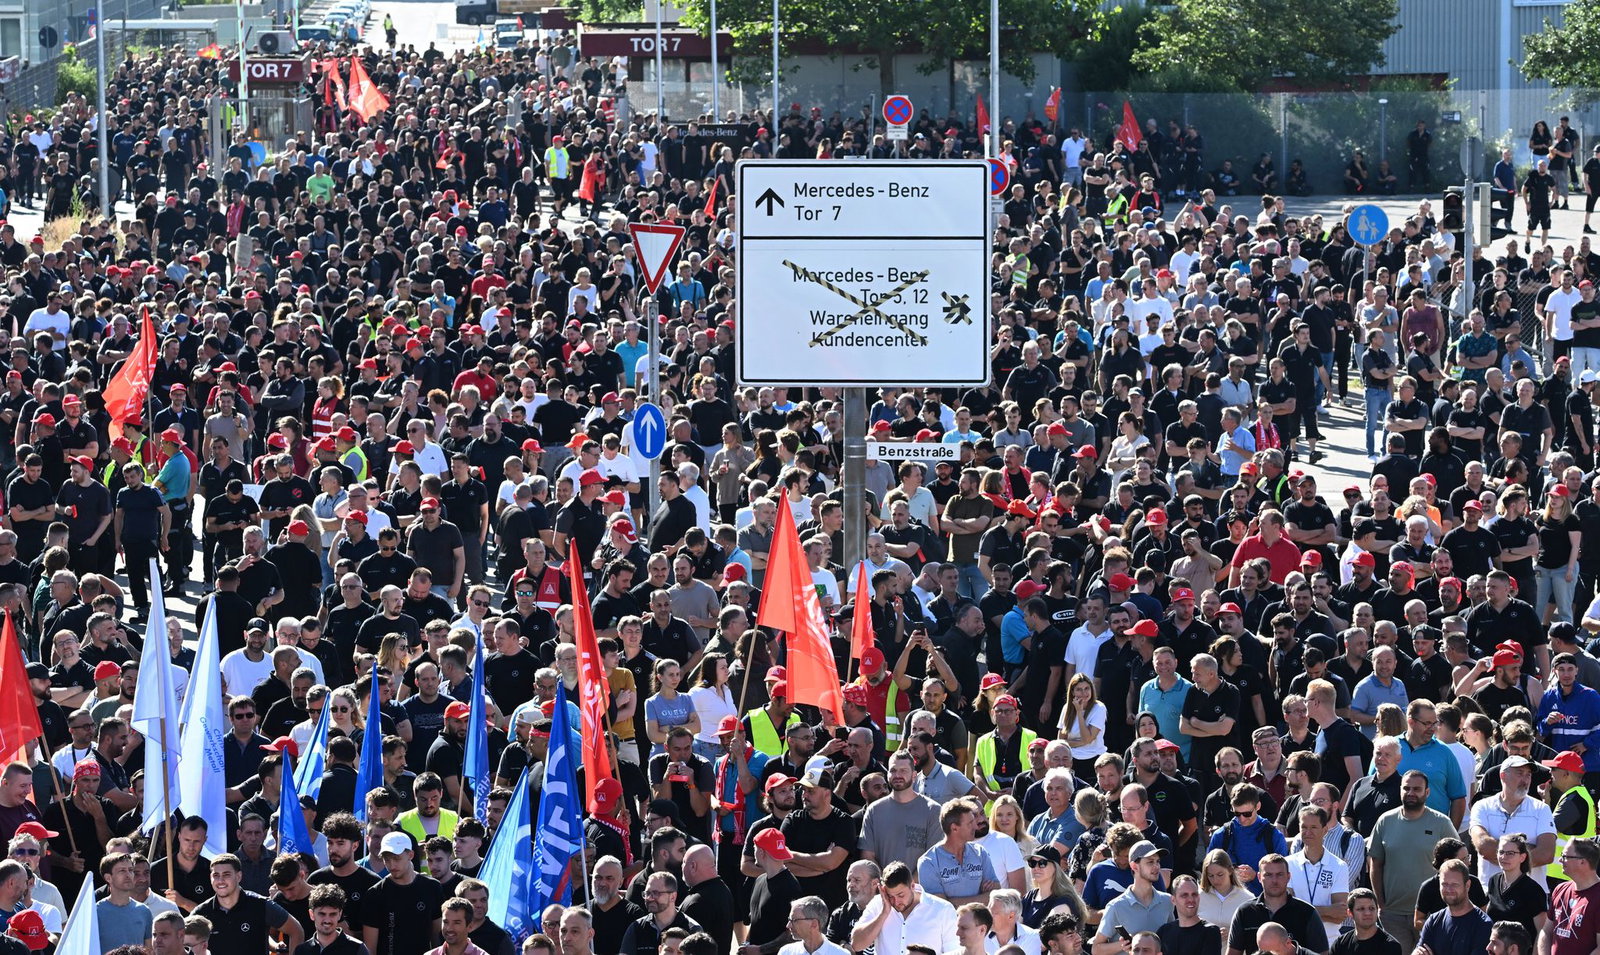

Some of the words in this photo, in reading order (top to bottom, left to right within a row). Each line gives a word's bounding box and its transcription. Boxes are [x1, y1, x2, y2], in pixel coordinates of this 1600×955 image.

[630, 38, 668, 52] TOR
[671, 38, 682, 52] 7
[281, 63, 292, 78] 7
[793, 205, 823, 221] Tor
[832, 205, 842, 221] 7
[913, 288, 929, 304] 12
[878, 446, 954, 457] Benzstraße
[204, 747, 221, 774] Metall
